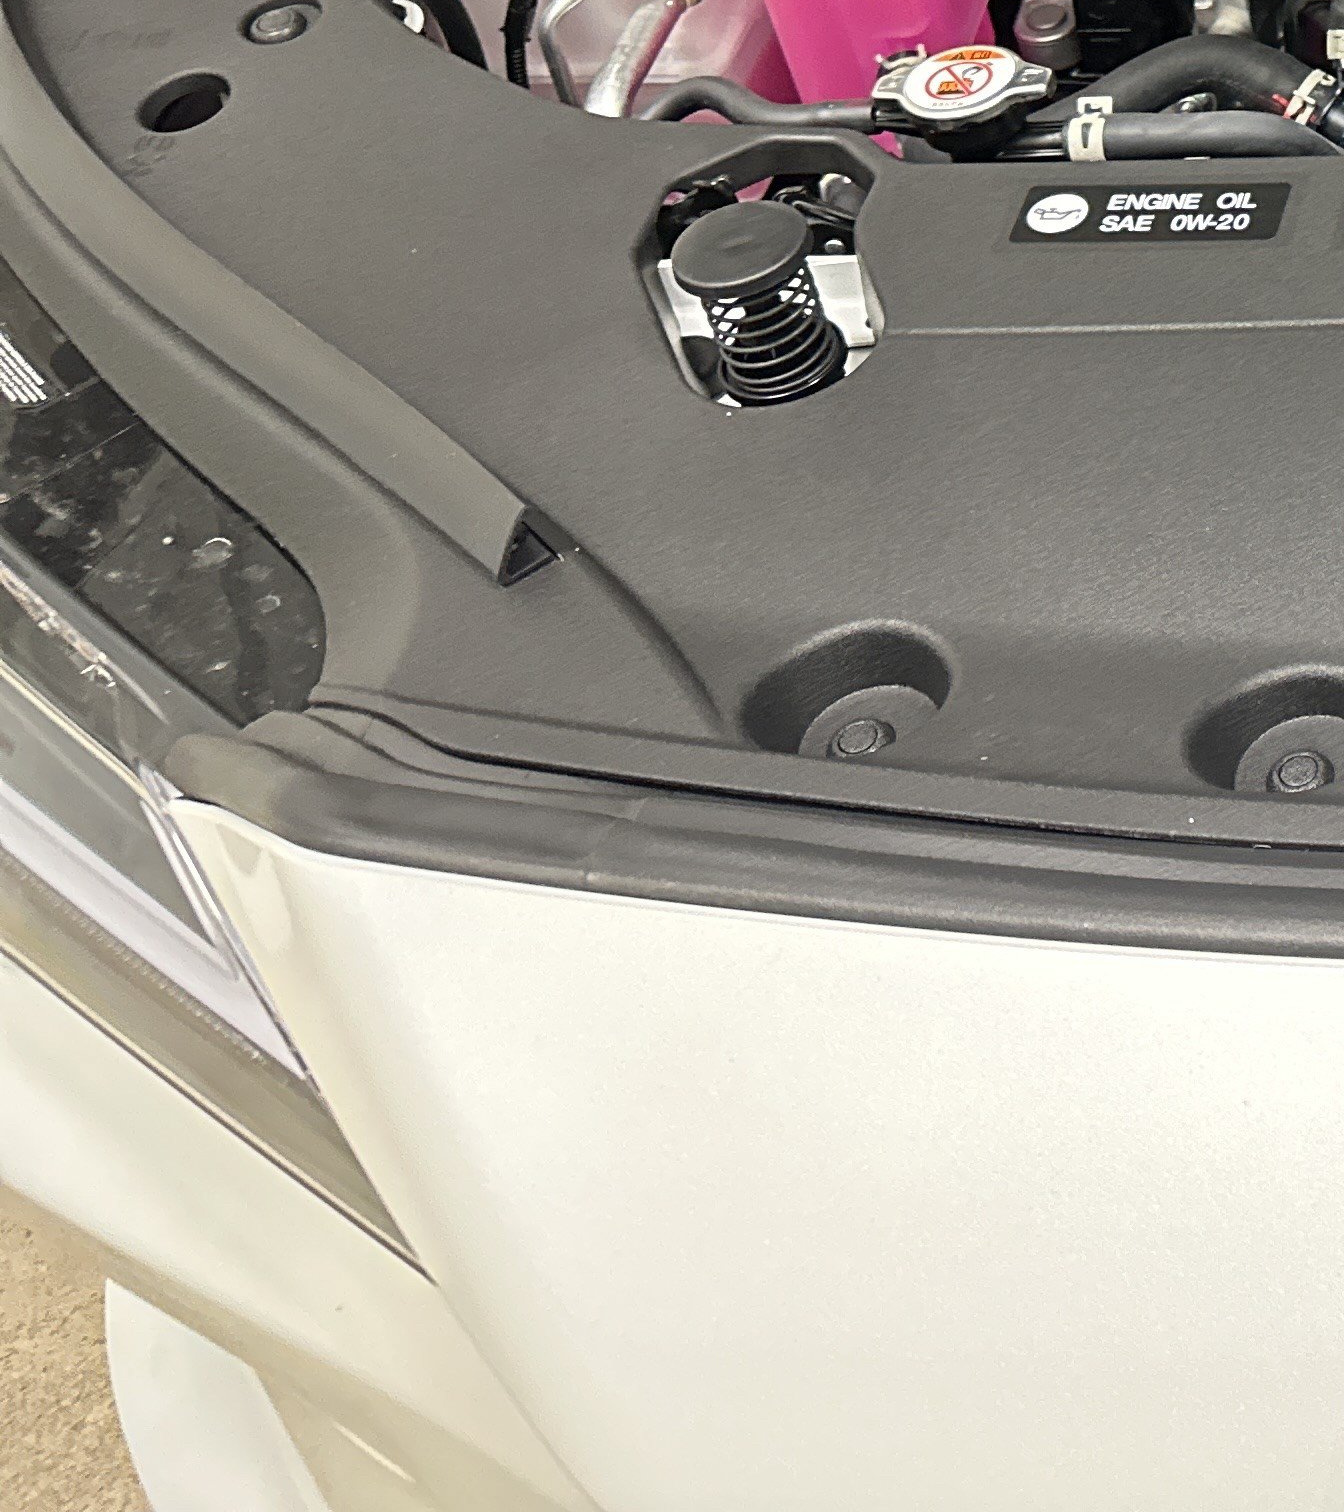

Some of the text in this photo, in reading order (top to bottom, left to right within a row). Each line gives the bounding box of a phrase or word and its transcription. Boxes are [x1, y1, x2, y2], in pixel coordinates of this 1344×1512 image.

[1106, 193, 1257, 211] ENGINE OIL
[1099, 213, 1250, 232] SAE 0W-20
